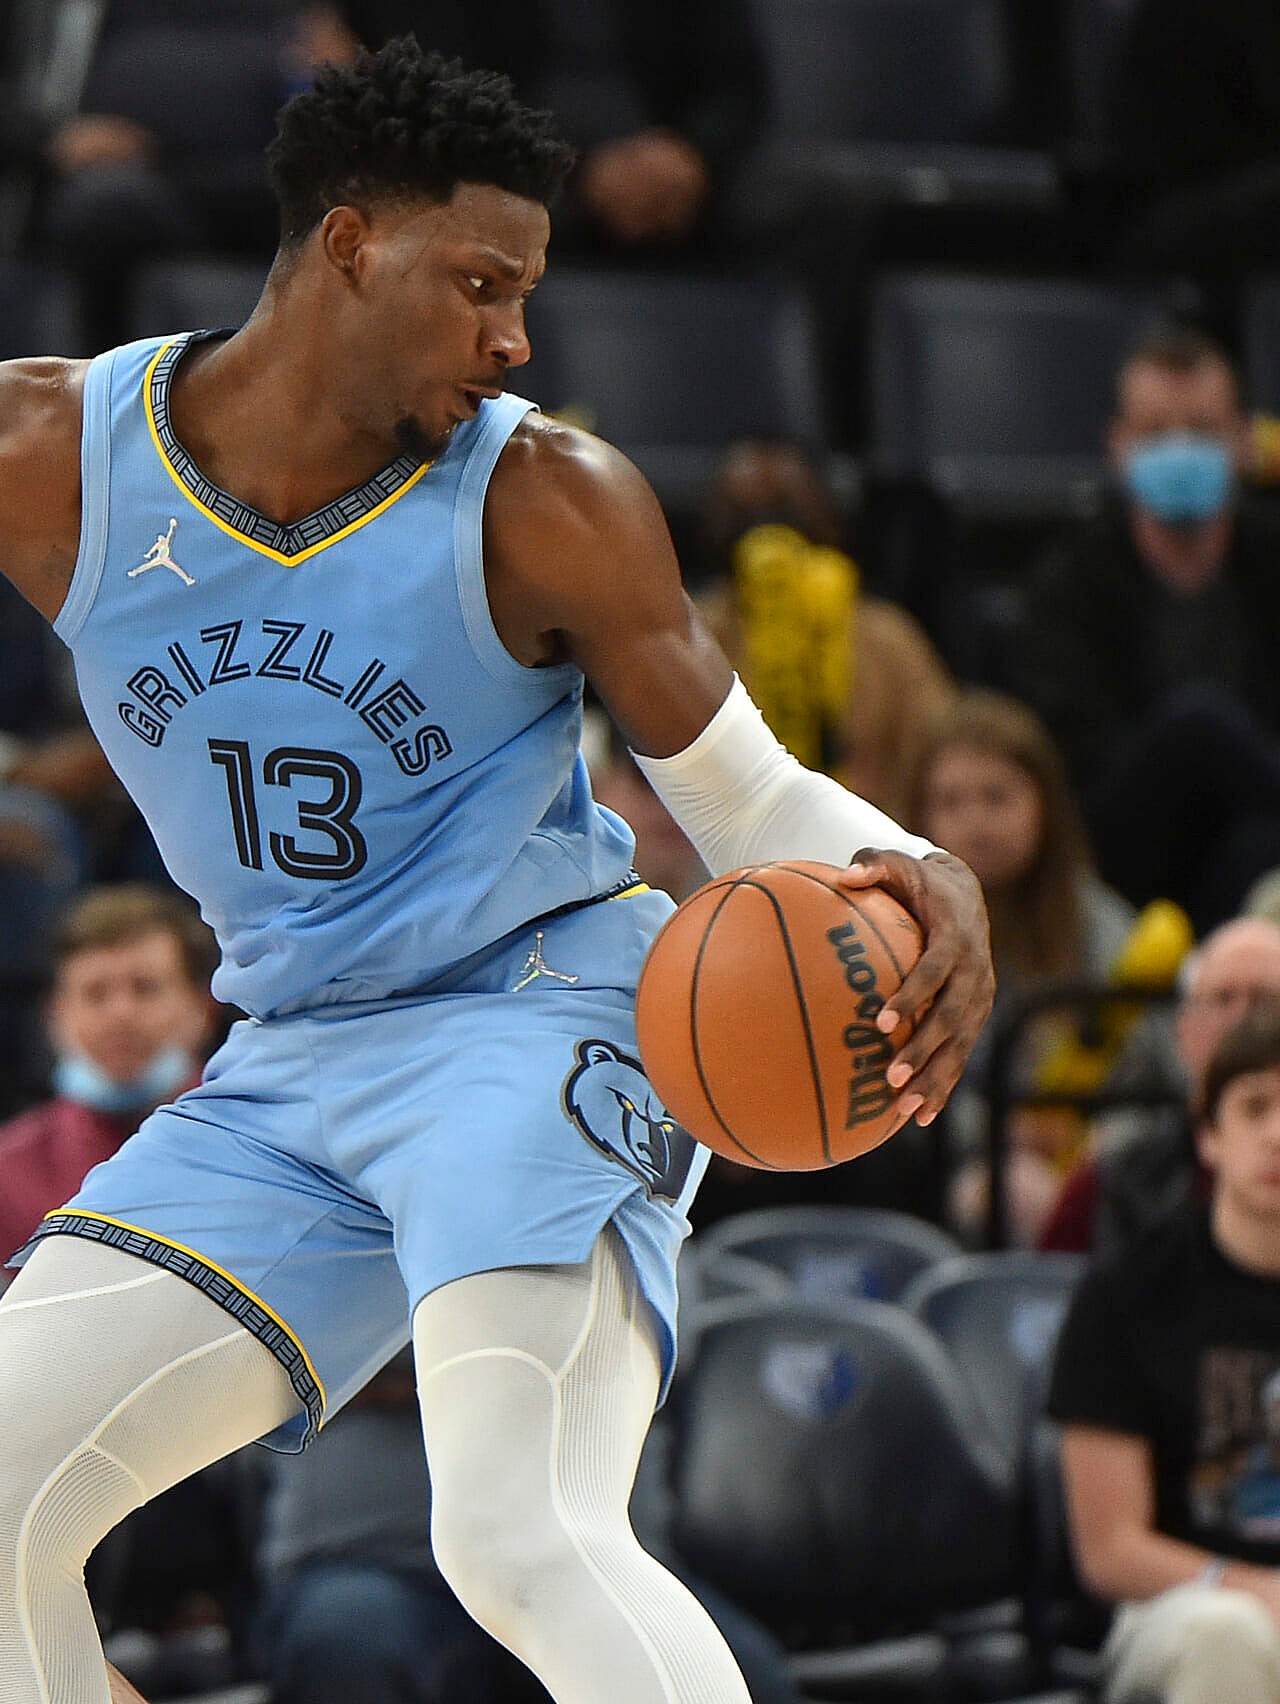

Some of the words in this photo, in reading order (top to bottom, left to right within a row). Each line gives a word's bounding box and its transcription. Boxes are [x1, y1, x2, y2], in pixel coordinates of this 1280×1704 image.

[118, 619, 454, 777] GRIZZLIES
[207, 738, 368, 881] 13
[826, 920, 894, 1127] Wilson
